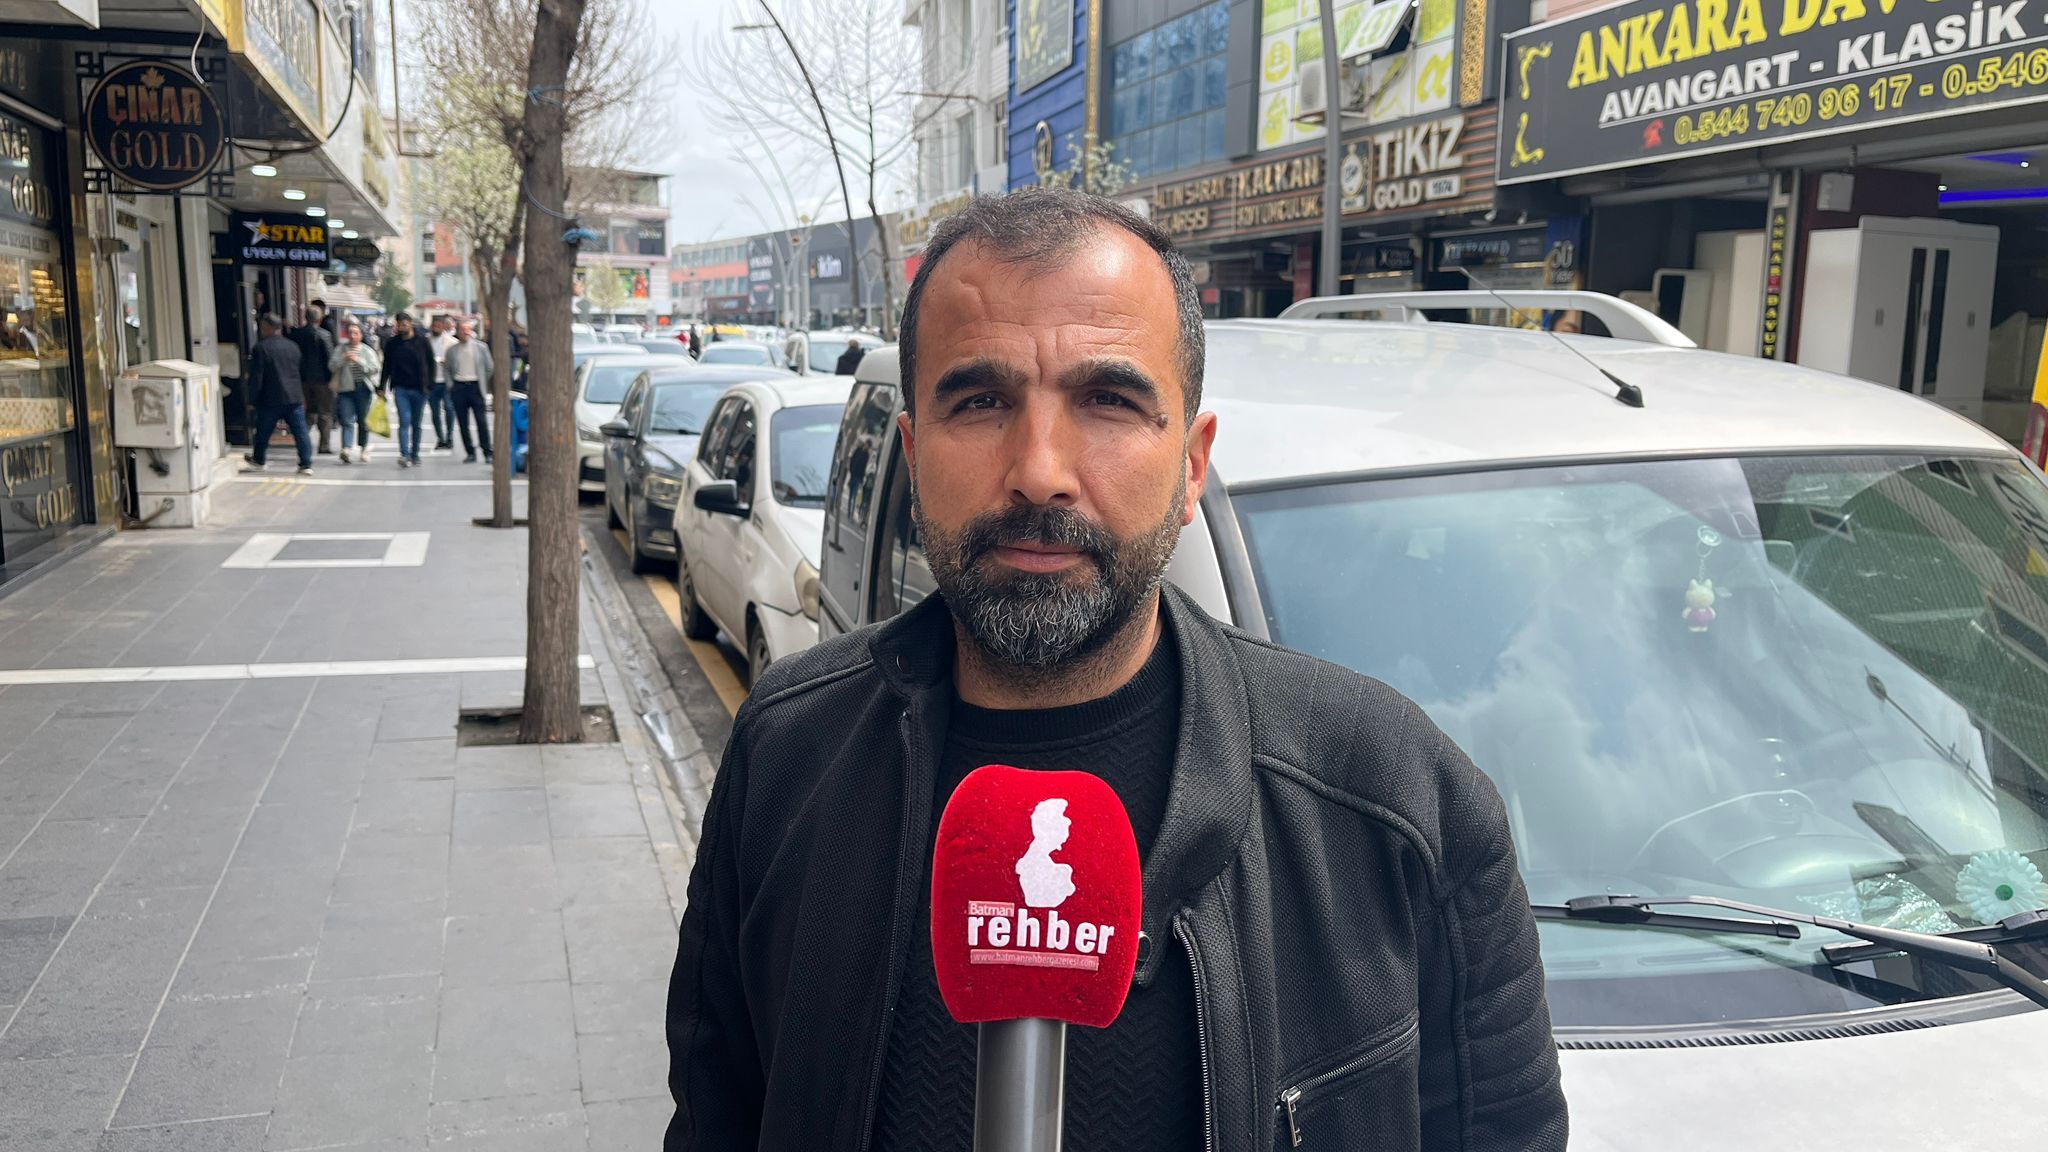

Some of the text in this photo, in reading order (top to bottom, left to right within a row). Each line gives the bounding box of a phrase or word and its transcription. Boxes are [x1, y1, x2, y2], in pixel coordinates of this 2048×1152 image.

[1567, 0, 1767, 89] ANKARA
[1599, 50, 1799, 123] AVANGART
[1837, 0, 2028, 74] KLASİK
[106, 83, 203, 127] ÇINAR
[1674, 103, 1749, 145] 0.544
[1755, 93, 1812, 131] 740
[1818, 83, 1860, 121] 96
[1869, 73, 1913, 111] 17
[1942, 47, 2048, 99] 0.546
[110, 129, 206, 171] GOLD
[1373, 113, 1465, 181] TİKİZ
[1238, 154, 1321, 199] KALKAN
[1373, 177, 1423, 211] GOLD
[242, 246, 286, 260] UYGUN
[270, 223, 326, 245] STAR
[968, 908, 1115, 954] rehber
[970, 903, 1014, 916] Batman
